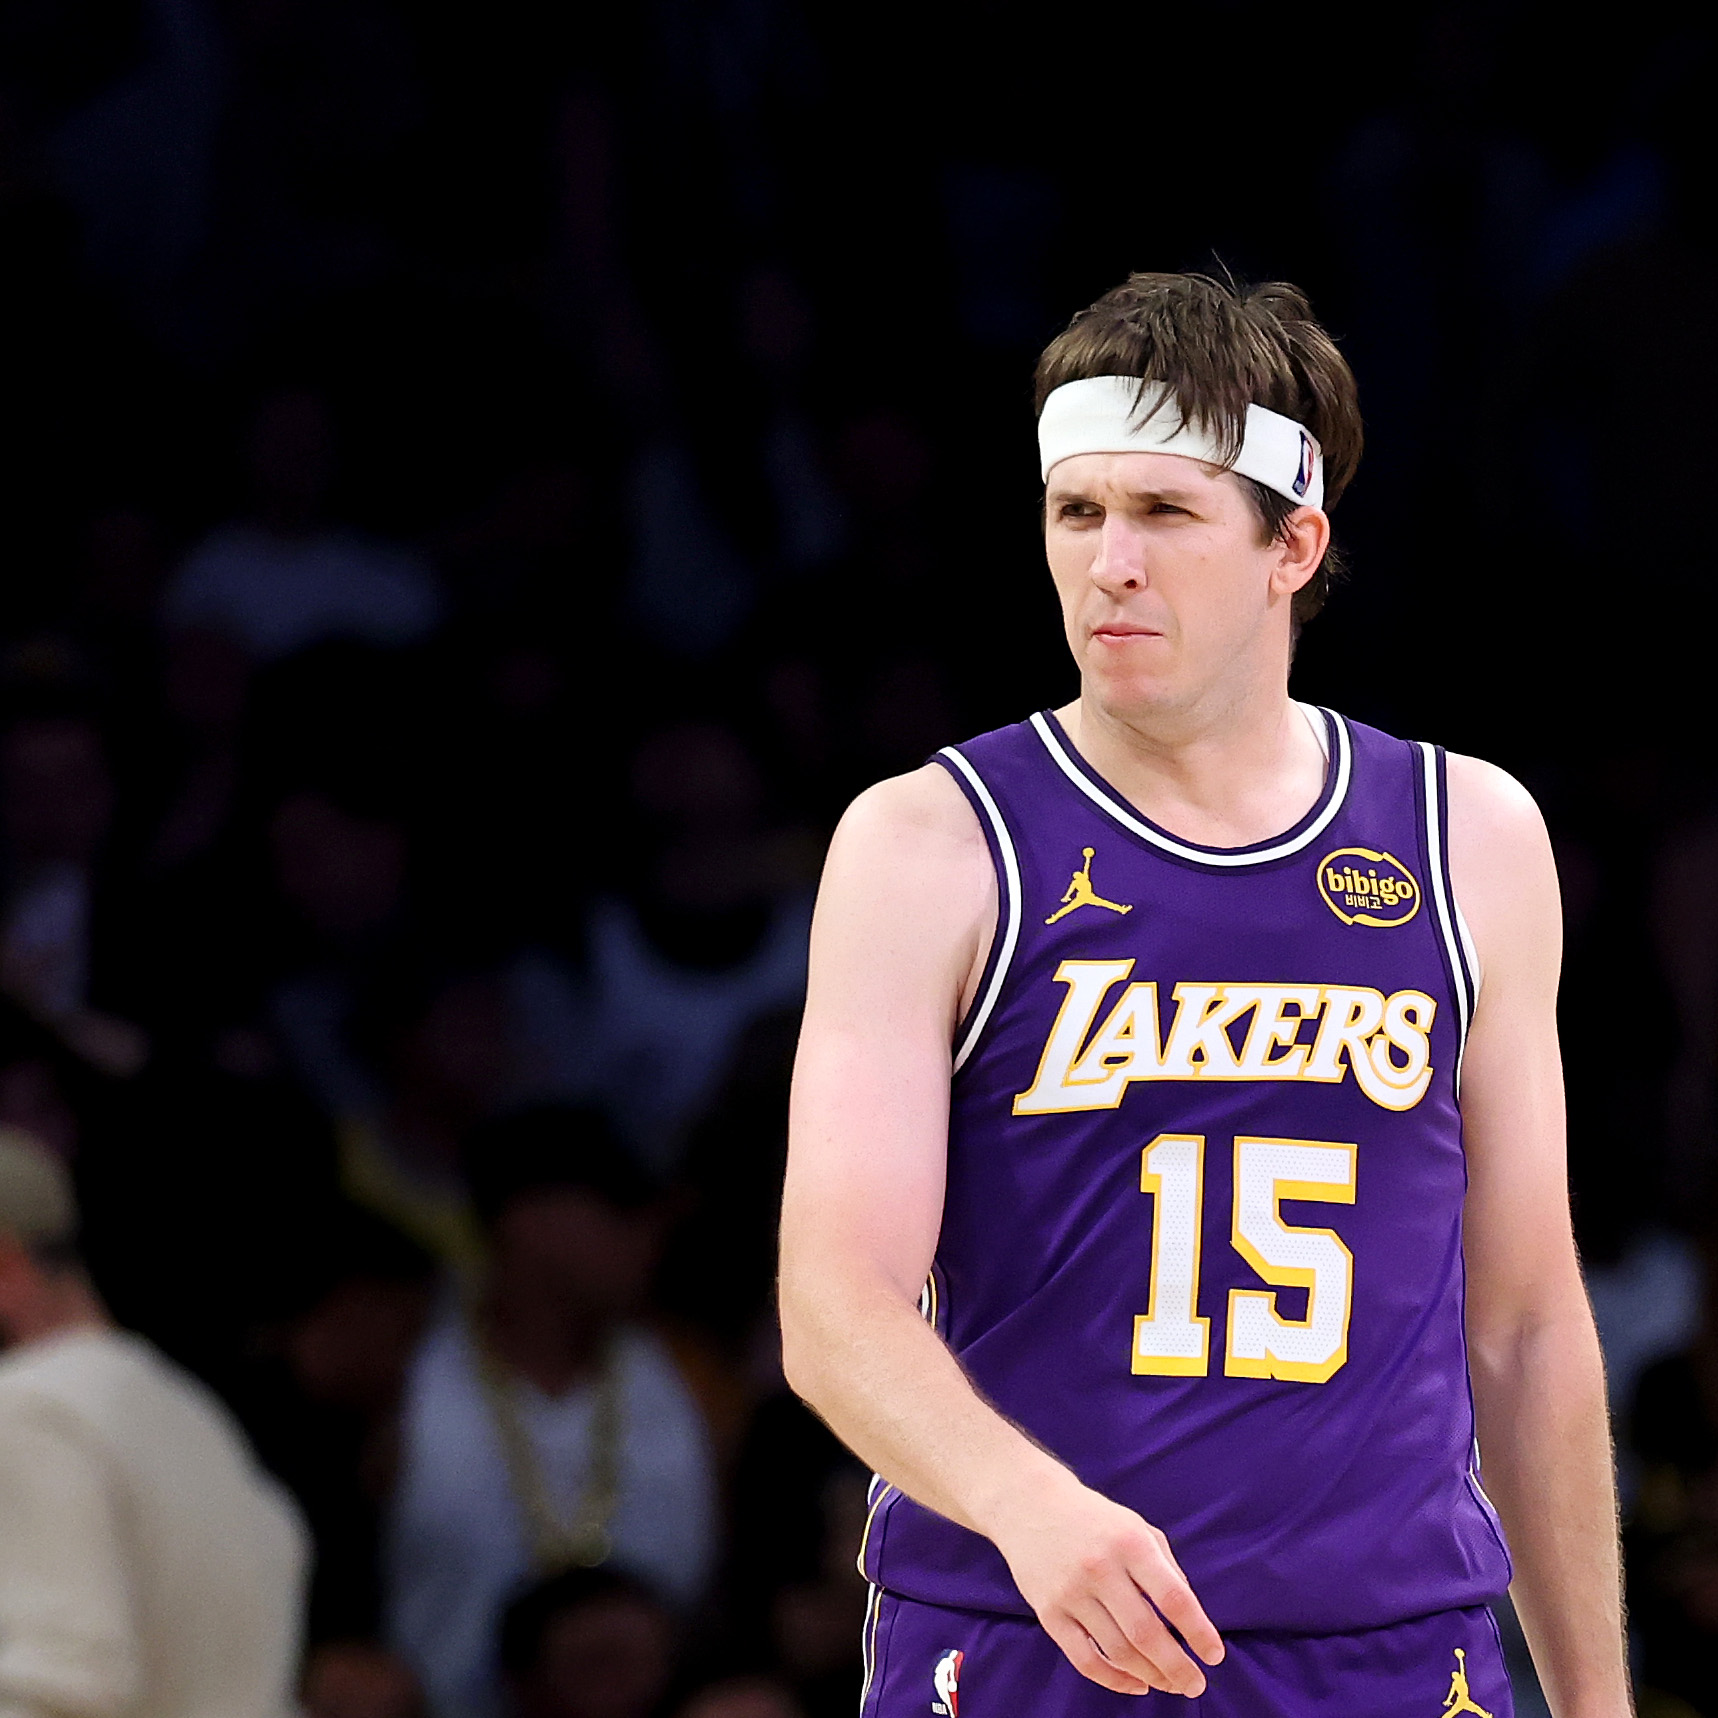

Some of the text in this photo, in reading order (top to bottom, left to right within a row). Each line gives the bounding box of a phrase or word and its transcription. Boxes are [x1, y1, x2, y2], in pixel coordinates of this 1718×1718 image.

[1326, 866, 1414, 906] bibigo
[1344, 893, 1384, 910] 비비고
[1011, 958, 1438, 1112] LAKERS
[1131, 1133, 1358, 1384] 15
